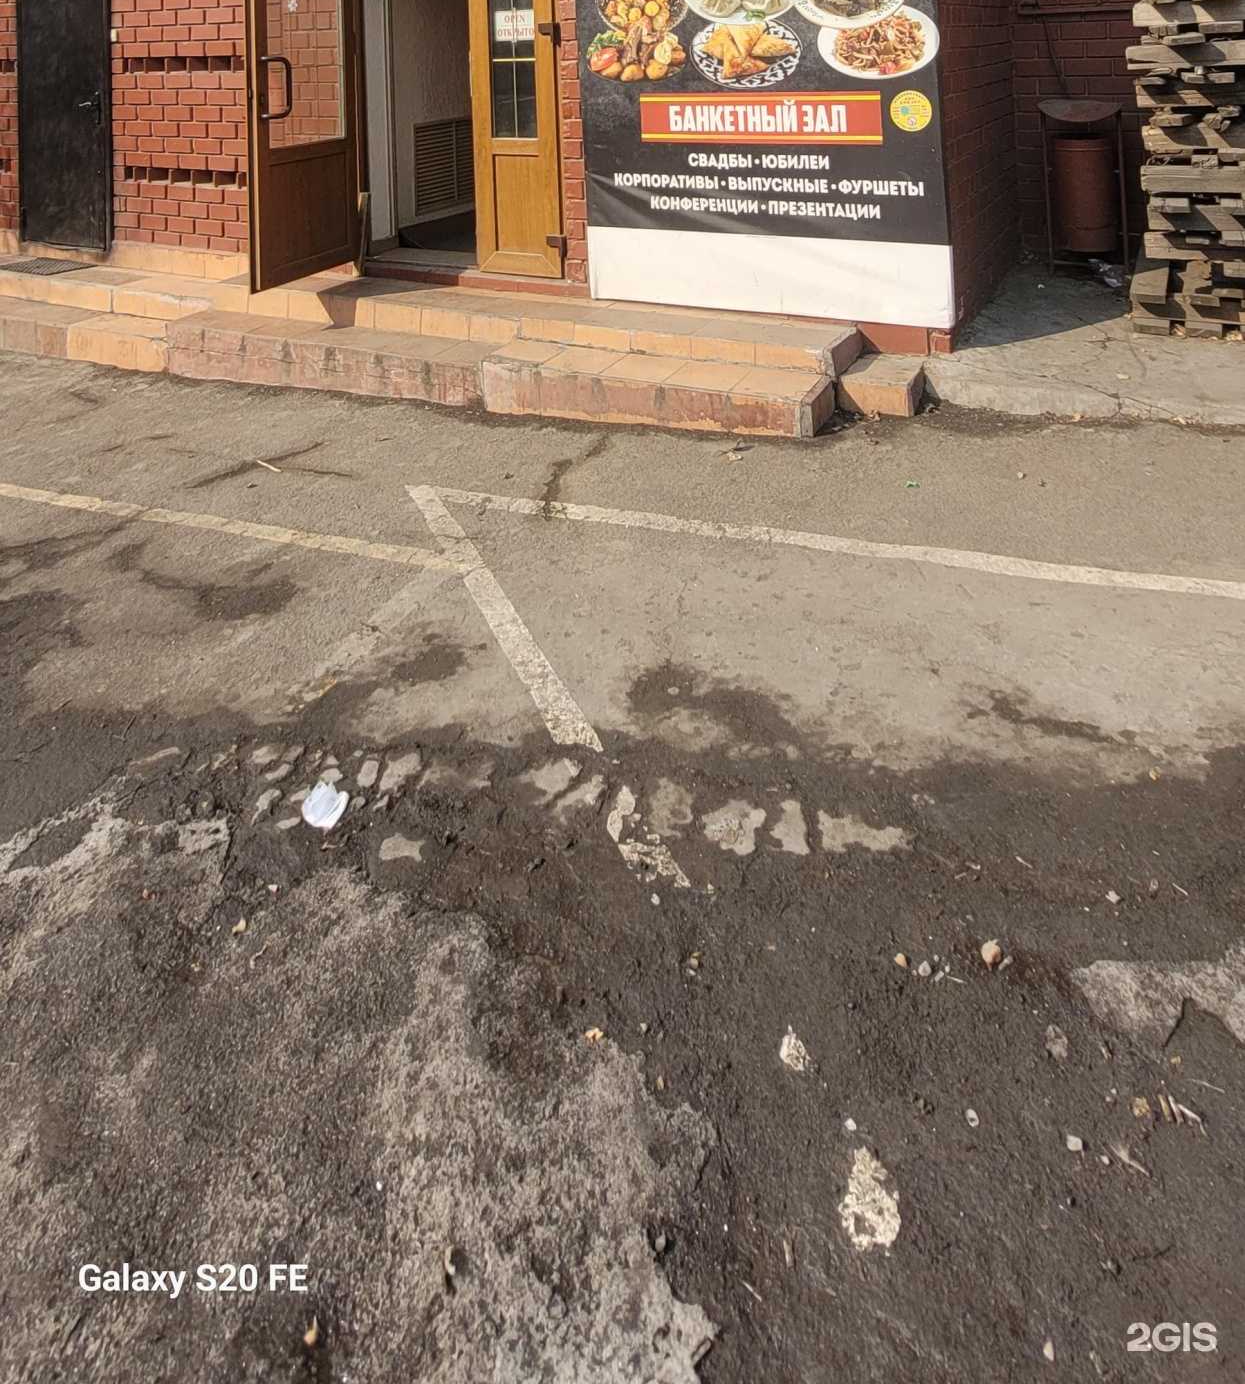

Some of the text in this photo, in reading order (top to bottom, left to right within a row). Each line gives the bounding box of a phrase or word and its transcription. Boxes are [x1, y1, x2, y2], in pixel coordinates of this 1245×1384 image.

[668, 99, 848, 133] БАНКЕТНЫЙ ЗАЛ
[688, 152, 830, 170] СВАДБЫ ЮБИЛЕИ
[613, 172, 924, 197] КОРПОРАТИВЫ ВЫПУСКНЫЕ ФУРШЕТЫ
[650, 195, 881, 220] КОНФЕРЕНЦИИ ПРЕЗЕНТАЦИИ
